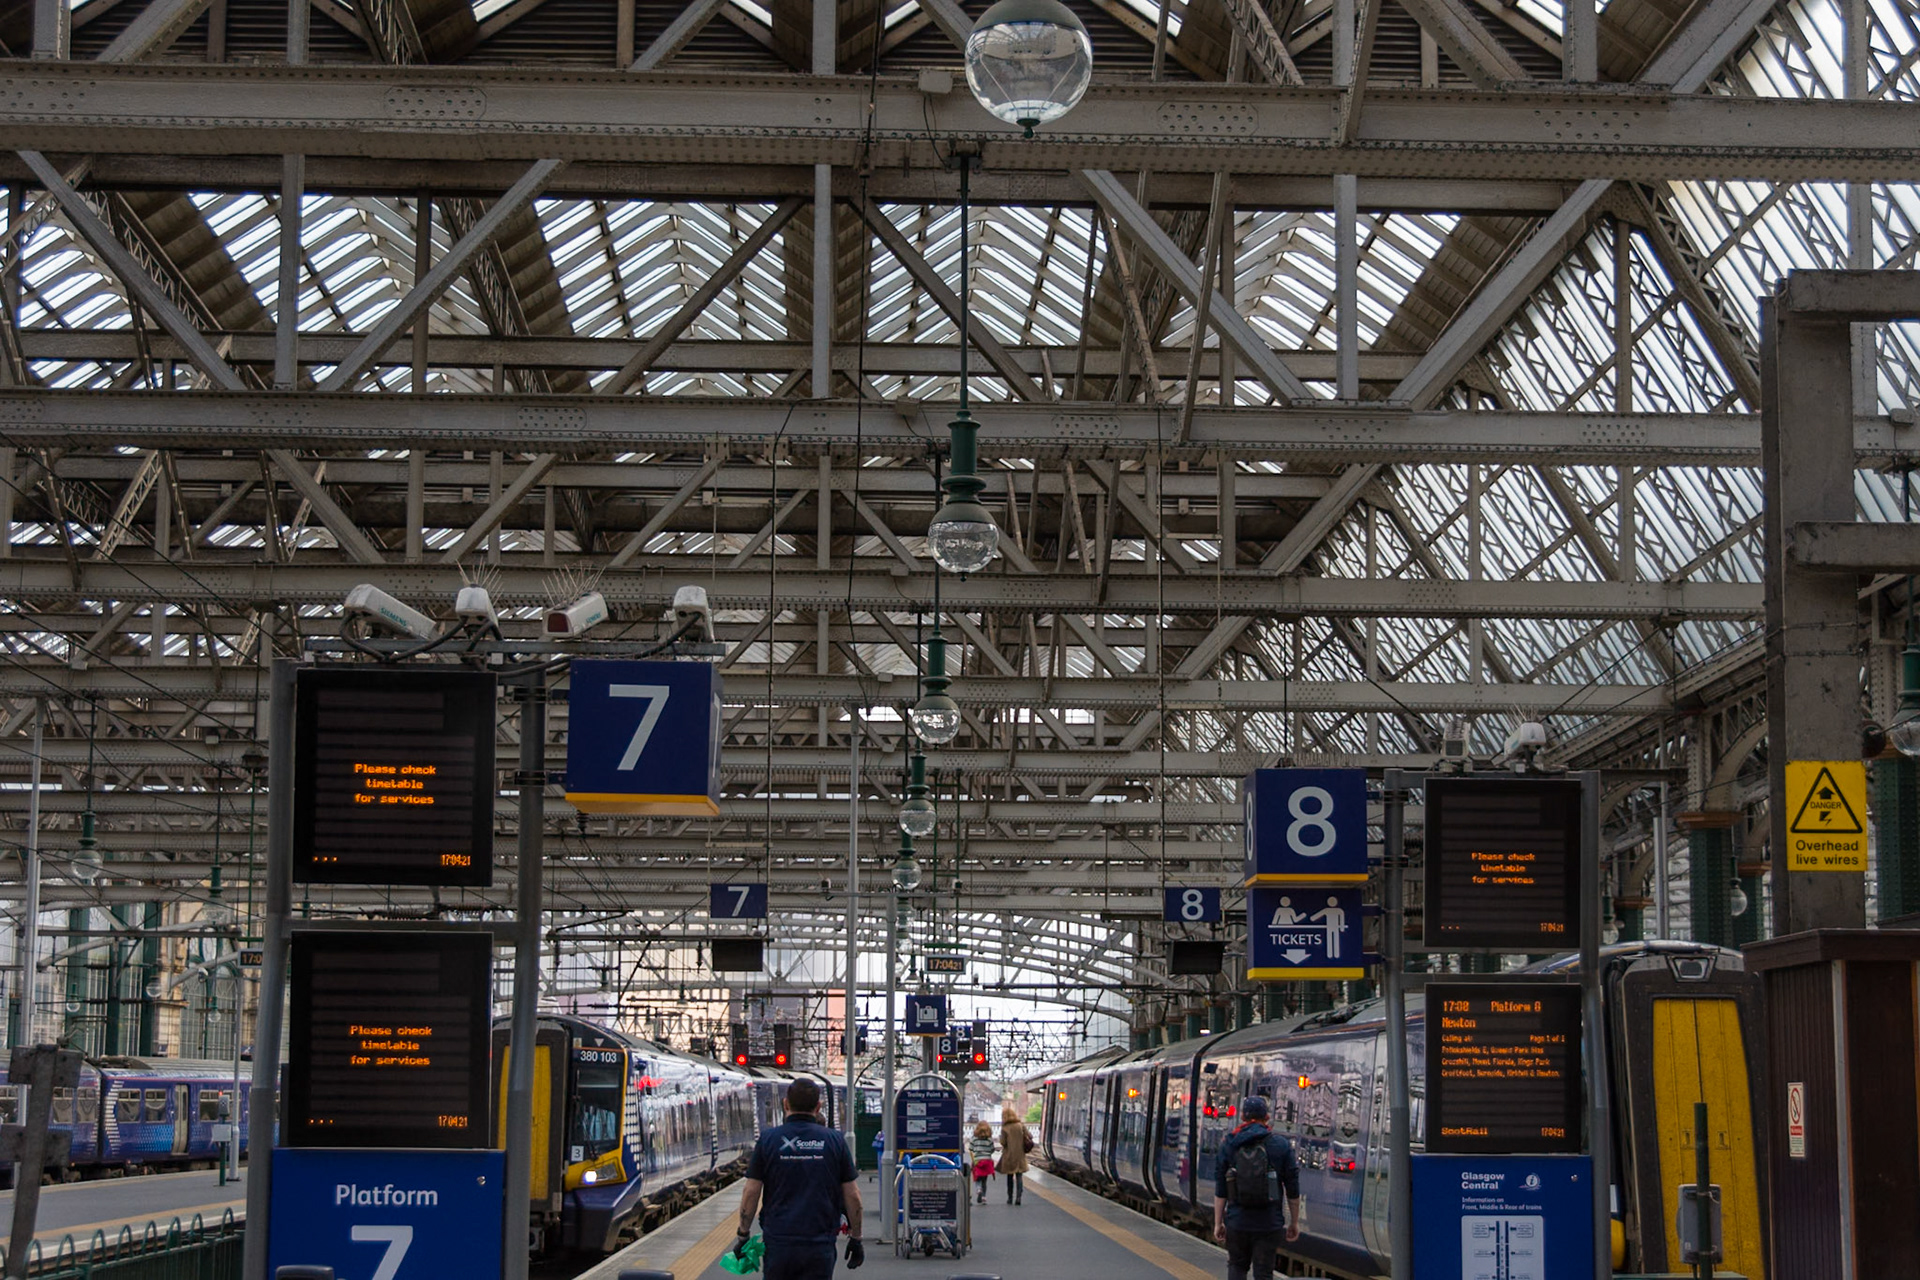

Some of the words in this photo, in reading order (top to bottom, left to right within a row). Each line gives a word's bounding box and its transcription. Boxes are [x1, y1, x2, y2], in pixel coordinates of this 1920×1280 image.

[609, 684, 670, 771] 7
[354, 763, 396, 775] Please
[401, 765, 436, 775] check
[366, 778, 424, 789] timetable
[355, 793, 375, 803] for
[380, 795, 434, 804] services
[1286, 786, 1337, 857] 8
[1795, 840, 1859, 851] Overhead
[1471, 852, 1504, 861] Please
[1507, 853, 1535, 861] check
[1796, 854, 1818, 865] live
[1824, 854, 1859, 865] wires
[1472, 876, 1488, 884] for
[727, 886, 750, 917] 7
[1181, 888, 1204, 920] 8
[1270, 934, 1322, 945] TICKETS
[1443, 1001, 1469, 1012] 17:08
[1490, 1001, 1531, 1012] Platform
[1442, 1018, 1477, 1028] Newton
[350, 1025, 391, 1035] Please
[397, 1026, 432, 1036] check
[956, 1026, 965, 1038] 8
[361, 1040, 420, 1050] timetable
[941, 1039, 951, 1052] 8
[351, 1055, 370, 1065] for
[376, 1057, 430, 1065] services
[580, 1051, 598, 1062] 380
[600, 1052, 617, 1063] 103
[1441, 1127, 1488, 1136] ScotRail
[575, 1149, 581, 1158] 3
[1461, 1172, 1505, 1182] Glasgow
[1461, 1181, 1499, 1190] Central
[336, 1184, 438, 1206] Platform
[352, 1225, 414, 1280] 7
